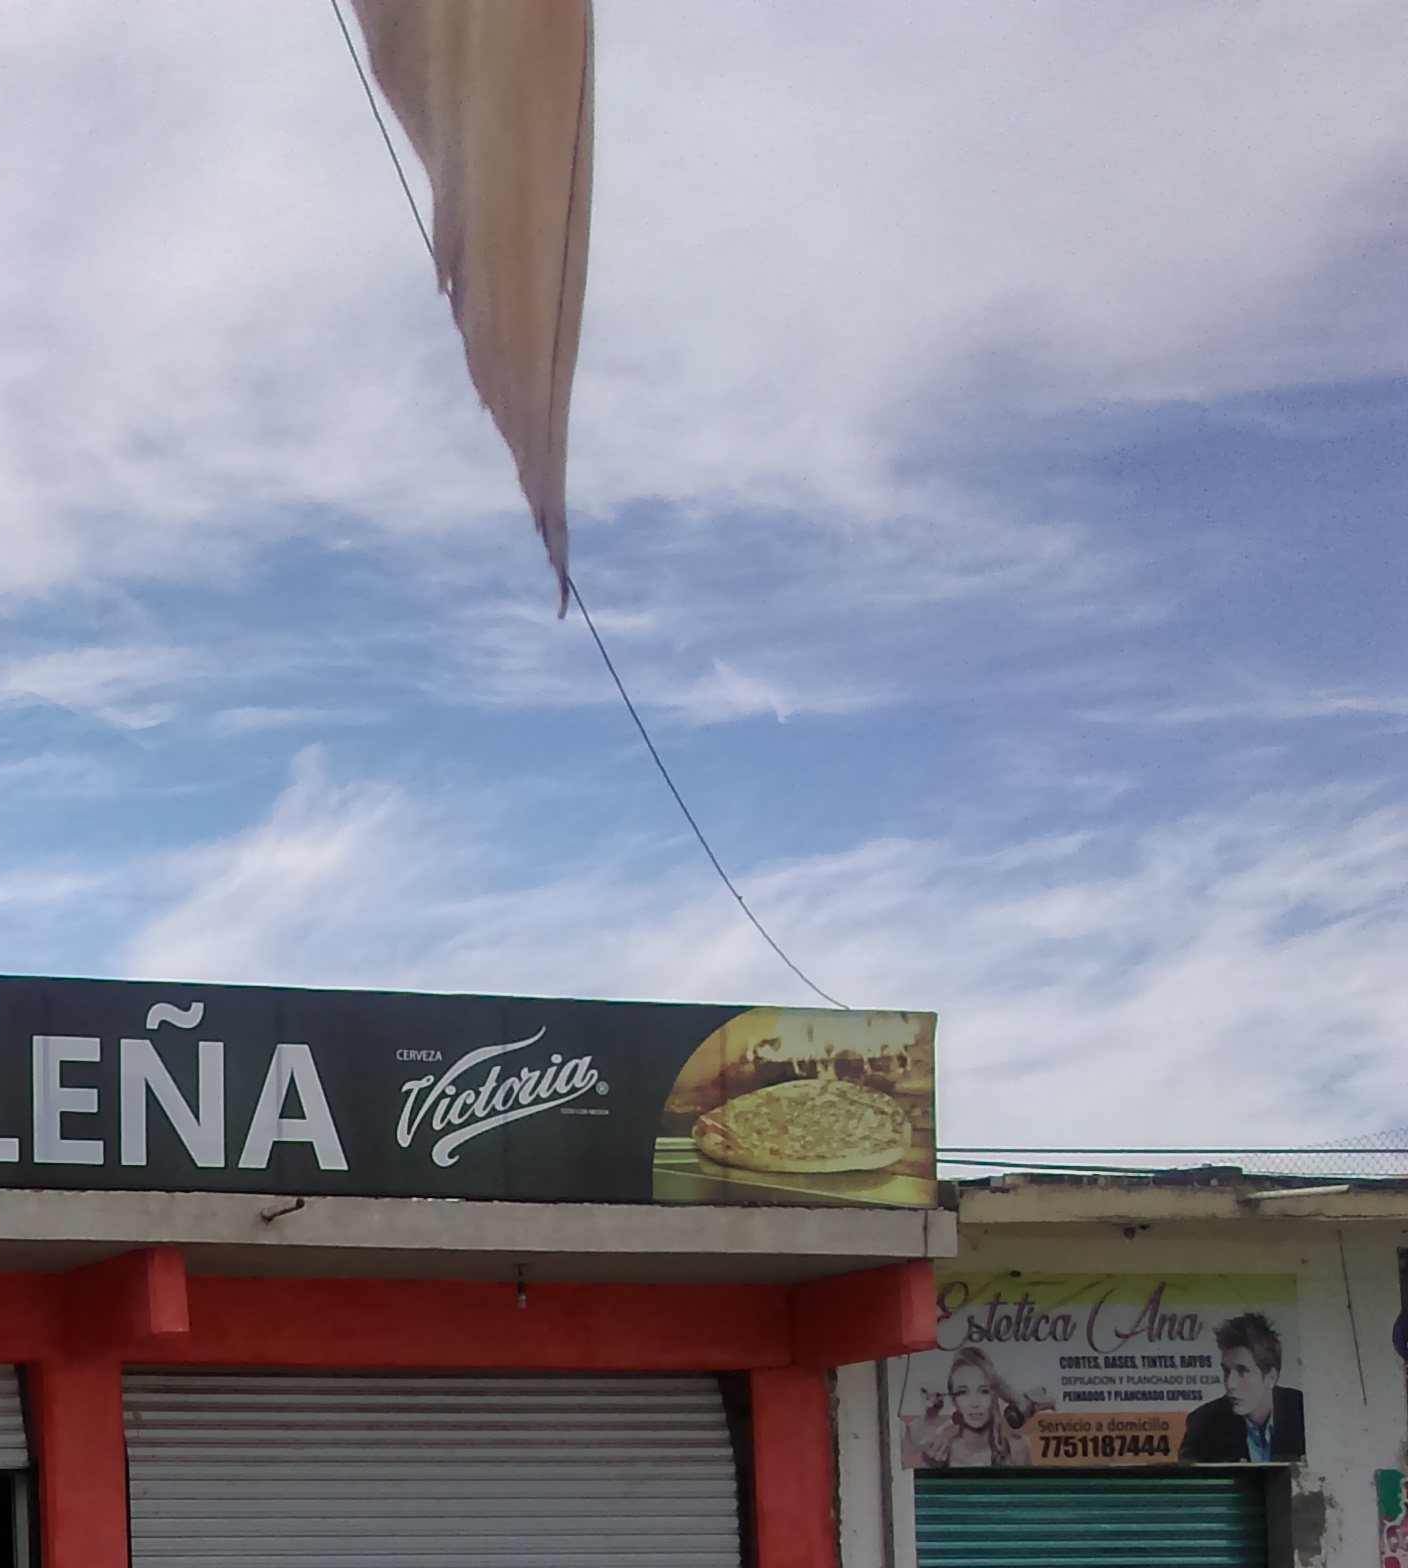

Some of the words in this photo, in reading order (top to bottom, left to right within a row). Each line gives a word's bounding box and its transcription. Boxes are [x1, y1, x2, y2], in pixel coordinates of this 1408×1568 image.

[396, 1049, 443, 1062] CERVEZA
[396, 1026, 599, 1168] Victoria
[1086, 1281, 1203, 1354] Ana
[1059, 1355, 1102, 1370] CORTES,
[1141, 1355, 1178, 1370] TINTES,
[1061, 1375, 1116, 1386] DEPILACION
[1126, 1375, 1184, 1386] PLANCHADO
[1186, 1375, 1197, 1385] DE
[1062, 1390, 1105, 1402] PEINADOS
[1114, 1390, 1164, 1402] PLANCHADO
[1166, 1389, 1203, 1401] EXPRESS
[1038, 1418, 1091, 1432] Servicio
[1096, 1422, 1103, 1431] a
[1107, 1418, 1170, 1432] domicilio
[1039, 1435, 1171, 1458] 7751187444
